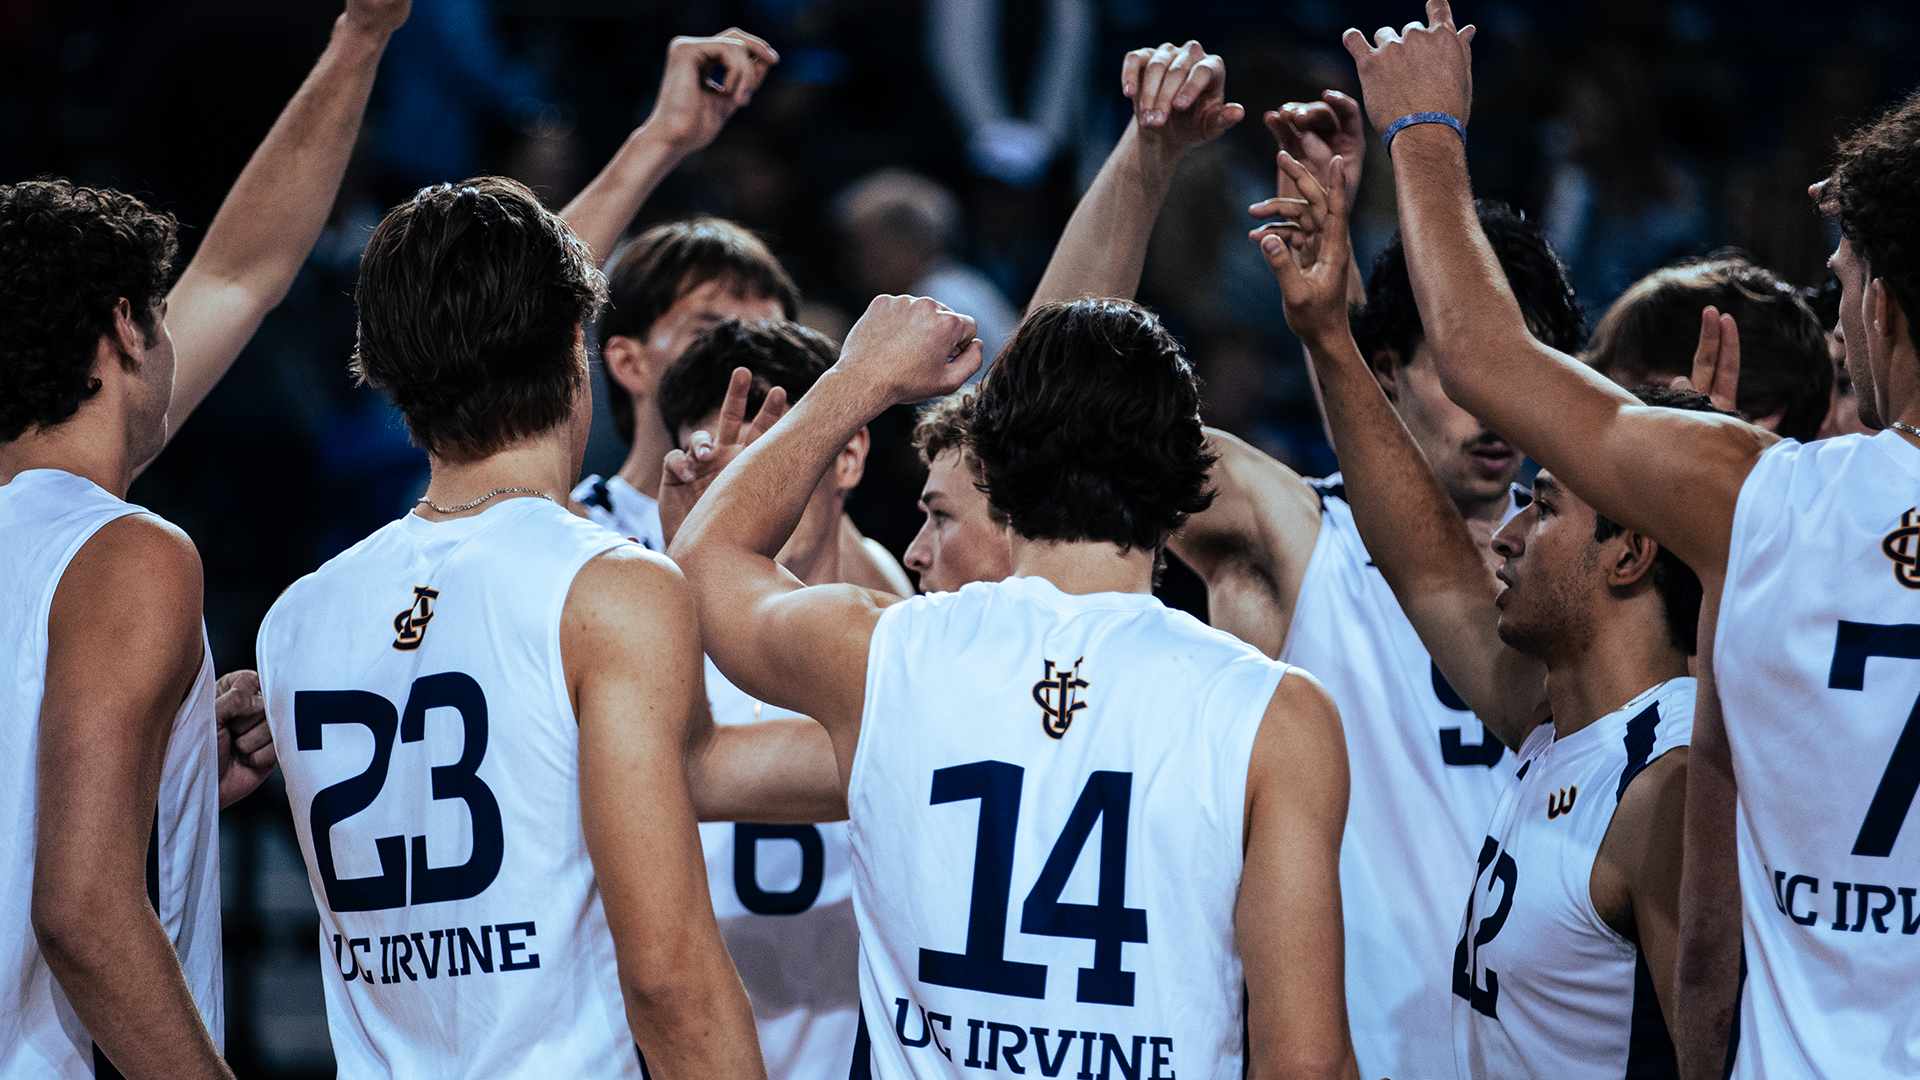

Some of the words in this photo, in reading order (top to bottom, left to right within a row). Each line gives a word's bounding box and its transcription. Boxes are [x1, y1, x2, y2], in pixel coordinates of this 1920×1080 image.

[294, 671, 505, 913] 23
[1828, 619, 1920, 857] 7
[333, 934, 375, 985] UC
[379, 921, 541, 985] IRVINE
[918, 759, 1149, 1007] 14
[895, 997, 953, 1063] UC
[964, 1018, 1177, 1080] IRVINE
